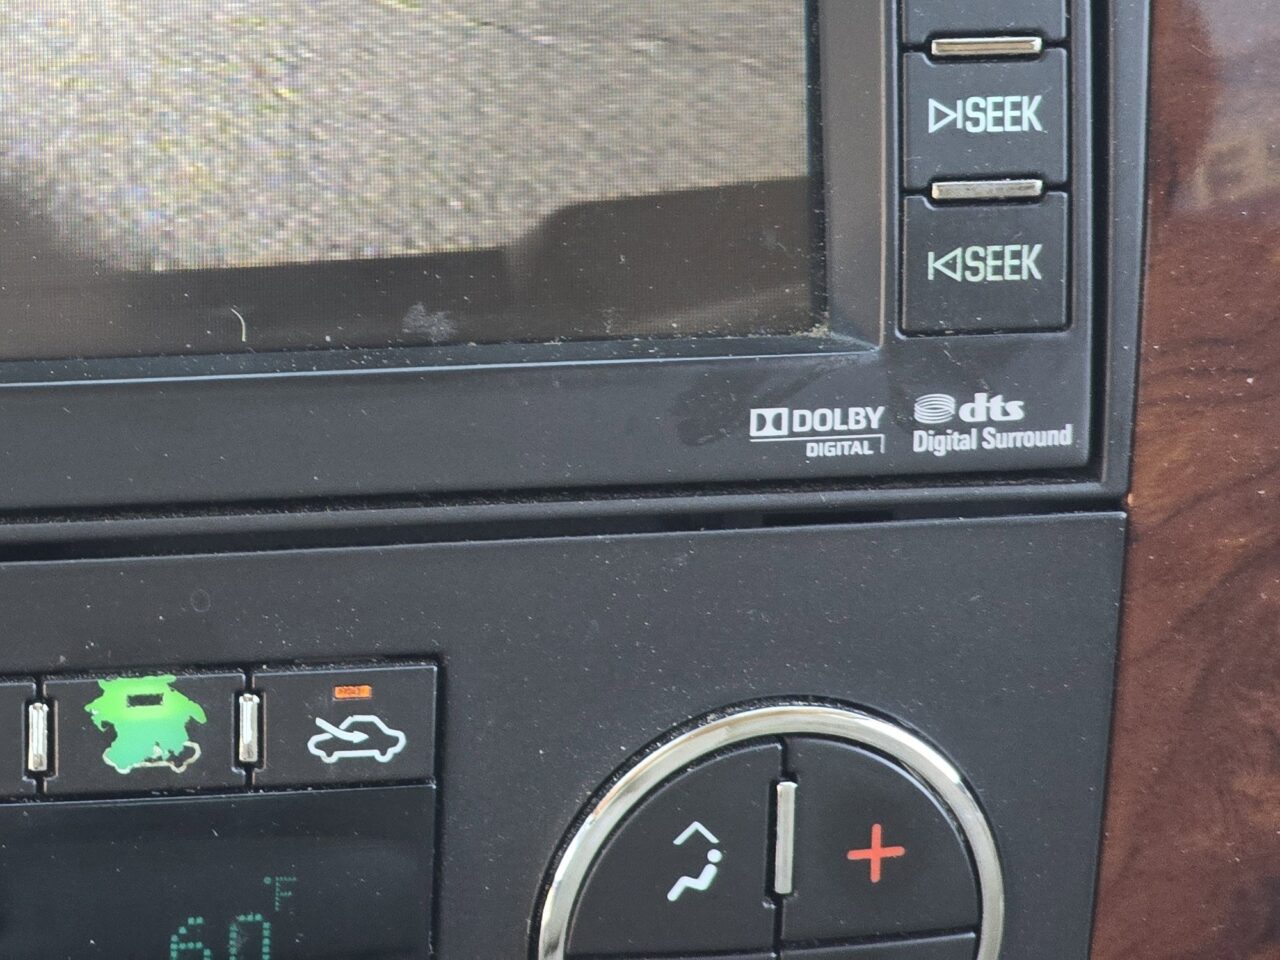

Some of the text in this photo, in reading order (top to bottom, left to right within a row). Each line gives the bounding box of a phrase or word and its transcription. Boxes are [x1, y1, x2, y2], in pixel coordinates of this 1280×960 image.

[964, 94, 1044, 134] SEEK
[963, 243, 1044, 283] SEEK
[792, 405, 886, 433] DOLBY
[958, 392, 1025, 423] dts
[805, 440, 875, 458] DIGITAL
[912, 424, 1074, 457] Digital Surround
